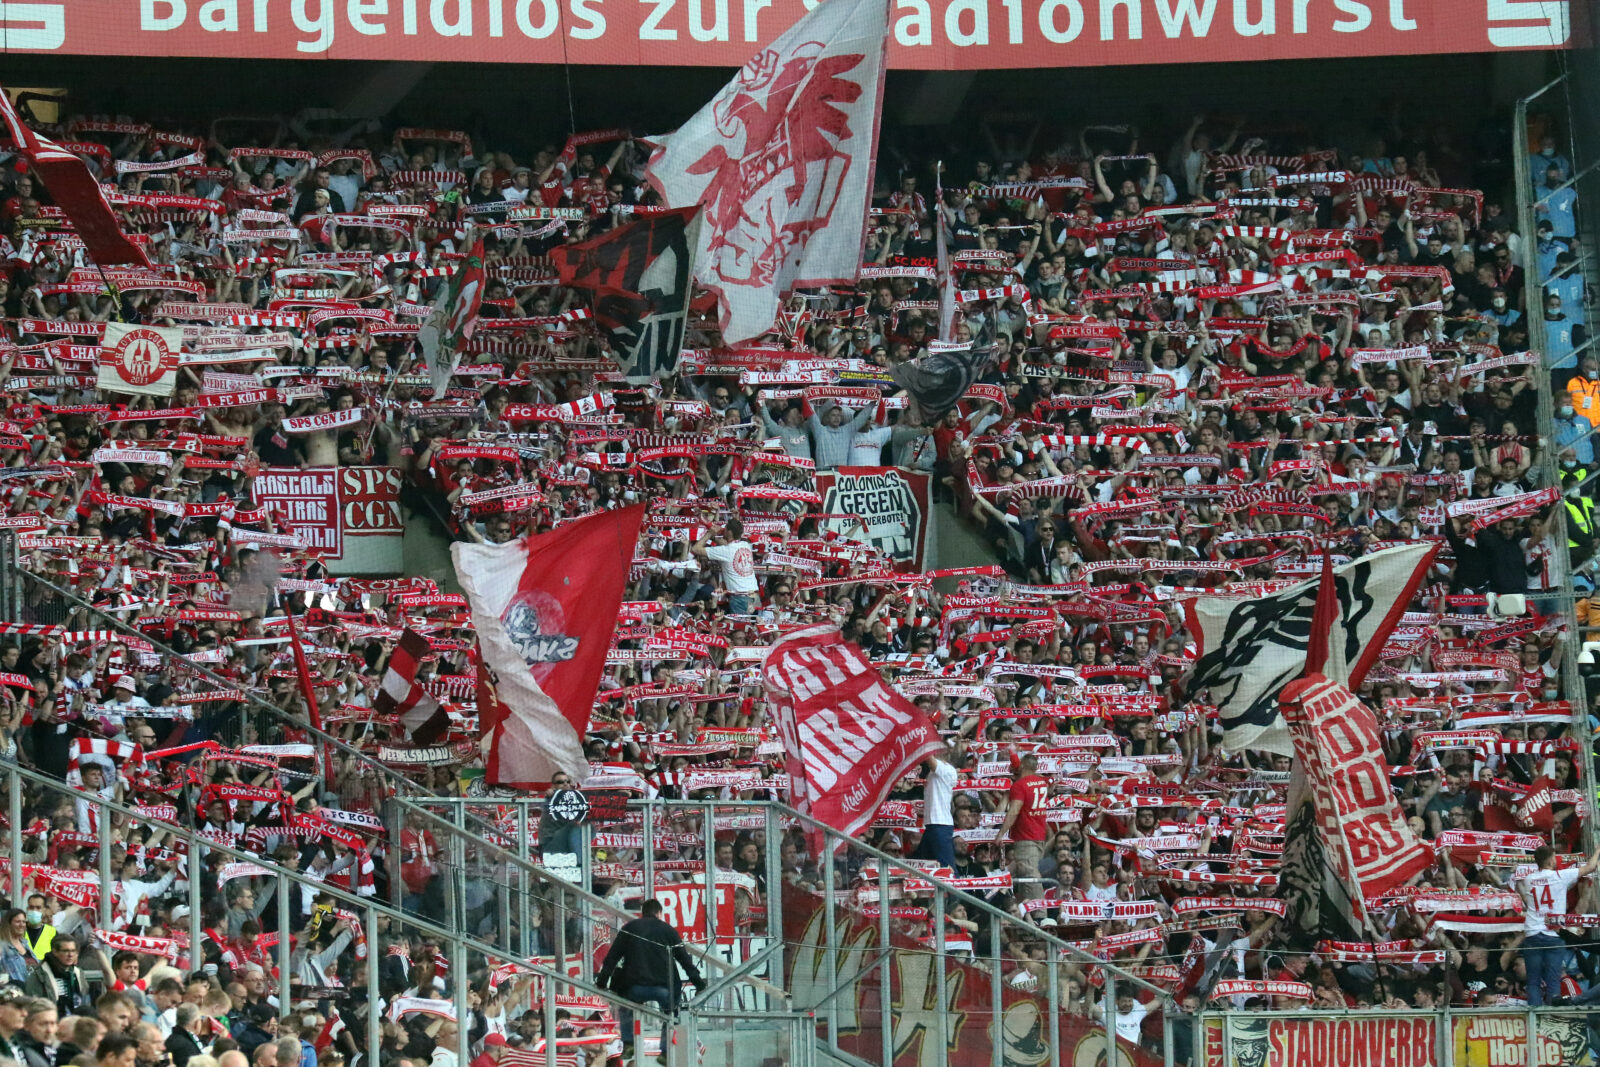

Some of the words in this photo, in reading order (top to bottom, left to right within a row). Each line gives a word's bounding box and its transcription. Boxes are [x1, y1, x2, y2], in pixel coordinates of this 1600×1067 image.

[890, 0, 1415, 48] adionwurst
[156, 133, 166, 141] FC
[169, 133, 194, 146] KÖLN
[64, 144, 98, 154] KÖLN
[1276, 172, 1346, 186] RAFIKIS
[895, 256, 908, 264] FC
[1284, 255, 1311, 264] 1.FC
[1316, 252, 1345, 262] Köln
[47, 322, 99, 335] CHAOTIX
[114, 329, 142, 366] CHAOTIX
[147, 329, 168, 370] COLONIA
[799, 360, 850, 372] COLONIACS
[758, 371, 812, 383] COLONIACS
[219, 396, 234, 408] FC
[238, 391, 268, 405] KÖLN
[127, 409, 149, 418] Jahre
[289, 417, 313, 429] SPS
[314, 414, 337, 426] CGN
[586, 430, 602, 438] FC
[606, 428, 645, 437] KÖLN
[1278, 461, 1292, 470] FC
[256, 475, 334, 495] RASCALS
[344, 468, 400, 496] SPS
[837, 472, 901, 493] COLONIACS
[107, 495, 122, 503] FC
[1161, 489, 1236, 497] KÖLN
[840, 488, 903, 515] GEGEN
[345, 500, 403, 529] CGN
[1289, 507, 1325, 517] KÖLN
[842, 512, 904, 528] STAVERBOTE!
[1149, 559, 1232, 570] DOUBLESIEGER
[350, 577, 427, 592] KÖLN
[208, 612, 238, 620] KÖLN
[994, 607, 1012, 615] AM
[1013, 607, 1048, 617] KÖLLE
[1493, 621, 1535, 638] KÖLN
[663, 629, 692, 640] 1.FC
[694, 633, 726, 646] Köln
[606, 651, 681, 660] OUBLESIEGER
[1083, 665, 1118, 675] ZESAMME
[991, 708, 1007, 716] FC
[1067, 706, 1100, 716] KÖLN
[380, 746, 449, 763] VEEDELSRADAU
[971, 777, 1006, 788] KÖLN
[220, 787, 278, 799] DOMSTADT
[1133, 787, 1144, 796] 1.
[1146, 787, 1164, 796] FC
[1031, 787, 1048, 810] 12
[331, 812, 346, 820] FC
[348, 813, 382, 827] KÖLN
[302, 815, 320, 831] FC
[321, 823, 353, 842] KÖLN
[596, 832, 663, 848] SYNDIKT
[1163, 834, 1181, 849] Köln
[49, 880, 61, 894] FC
[61, 885, 84, 904] KÖLN
[1530, 884, 1556, 912] 14
[108, 932, 168, 951] KÖLN
[1352, 944, 1365, 952] FC
[1467, 1014, 1526, 1042] Junge
